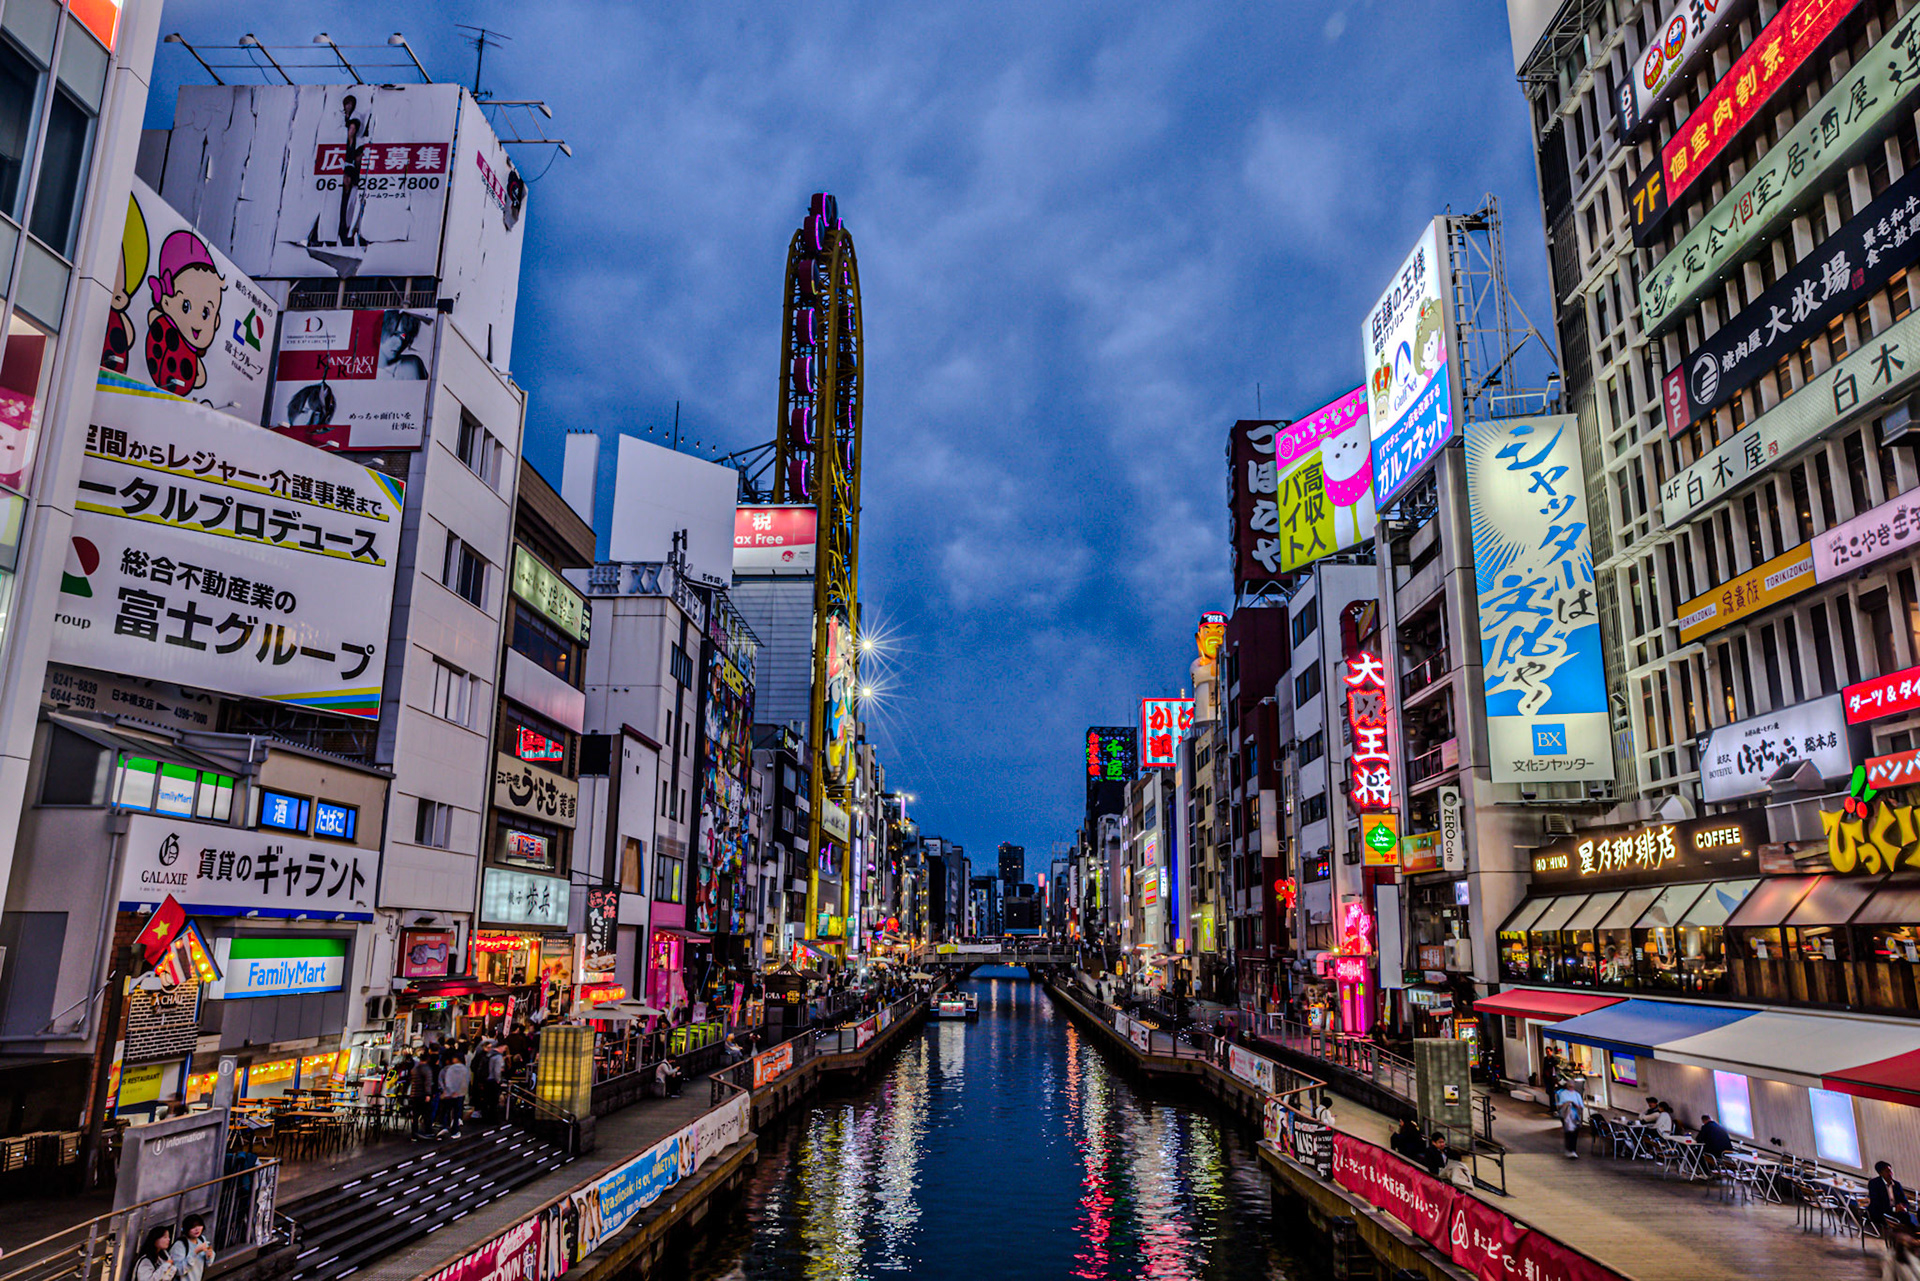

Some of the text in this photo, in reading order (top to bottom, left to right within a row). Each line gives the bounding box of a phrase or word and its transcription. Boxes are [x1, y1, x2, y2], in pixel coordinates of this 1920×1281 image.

[1652, 53, 1684, 98] NIKO NIKO
[1620, 83, 1633, 131] 8F
[1669, 35, 1785, 183] 個室肉割烹
[315, 176, 440, 191] 06-282-7800
[1682, 75, 1879, 283] 完全個室居酒屋
[1632, 171, 1661, 226] 7F
[1863, 195, 1920, 250] 黒毛和牛
[235, 279, 273, 318] 総合不動産業の
[1372, 245, 1426, 344] 店舗の王様
[1721, 250, 1851, 374] 焼肉屋 大牧場
[224, 340, 265, 376] 富士グループ
[315, 353, 375, 370] KANZAKI
[337, 364, 373, 378] RUKA
[349, 411, 412, 421] めっちゃ面白いを
[1668, 375, 1684, 428] 5F
[1295, 399, 1357, 445] いちごなび
[1377, 403, 1448, 498] ガルフネット
[1686, 431, 1766, 509] 白木屋
[1666, 478, 1680, 502] 4F
[752, 512, 772, 531] 税
[1282, 469, 1304, 564] バイト
[1303, 461, 1326, 557] 高収入
[755, 533, 784, 545] Free
[120, 546, 297, 614] 総合不動産業の
[1766, 561, 1810, 588] TORIKIZOKU
[54, 610, 92, 630] roup
[113, 586, 375, 681] 富士グループ
[1680, 608, 1713, 629] TORIKIZOKU
[50, 688, 96, 709] 6644-5573
[111, 688, 154, 710] 日本橋支店
[1346, 652, 1391, 806] 大阪王将
[1536, 731, 1563, 747] BX
[1804, 731, 1838, 753] 総本店
[158, 789, 192, 805] FamilyMart
[508, 766, 559, 816] うなぎ
[273, 798, 287, 825] 酒
[315, 805, 345, 834] たばこ
[1443, 808, 1456, 839] ZERO
[1578, 825, 1677, 875] 星乃珈琲店
[1696, 827, 1741, 849] COFFEE
[196, 845, 366, 900] 賃貸のギャラント
[1383, 854, 1397, 863] 2F
[1535, 854, 1569, 872] HOHINO
[141, 869, 188, 886] GALAXIE
[526, 881, 550, 917] 歩兵
[604, 890, 617, 919] 大阪
[247, 960, 326, 988] FamilyMart
[165, 1131, 206, 1150] information
